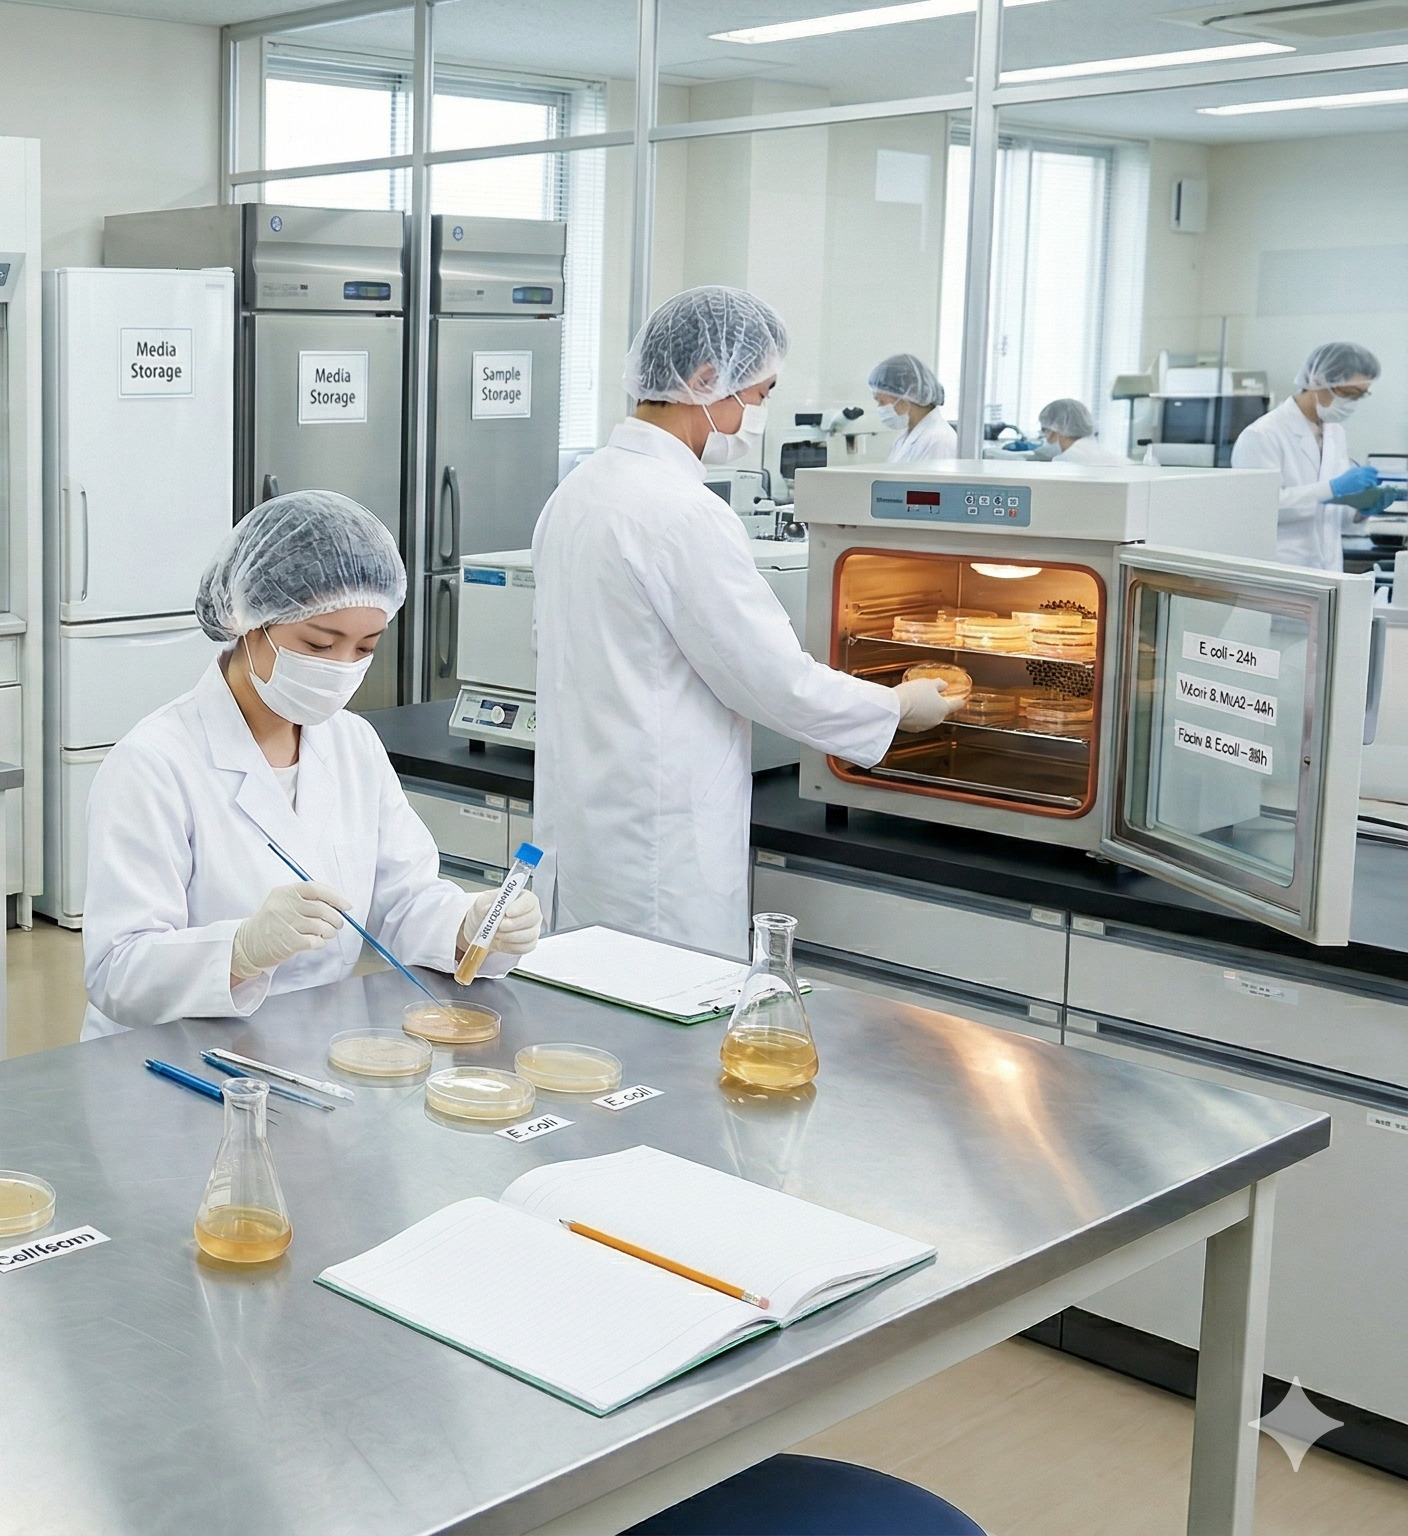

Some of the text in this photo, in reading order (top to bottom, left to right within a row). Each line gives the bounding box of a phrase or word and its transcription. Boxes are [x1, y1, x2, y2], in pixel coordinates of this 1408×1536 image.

[136, 341, 177, 357] Media
[131, 363, 182, 382] Storage
[315, 367, 351, 383] Media
[482, 366, 521, 384] Sample
[310, 389, 356, 408] Storage
[482, 386, 522, 404] Storage
[528, 1117, 559, 1133] coli
